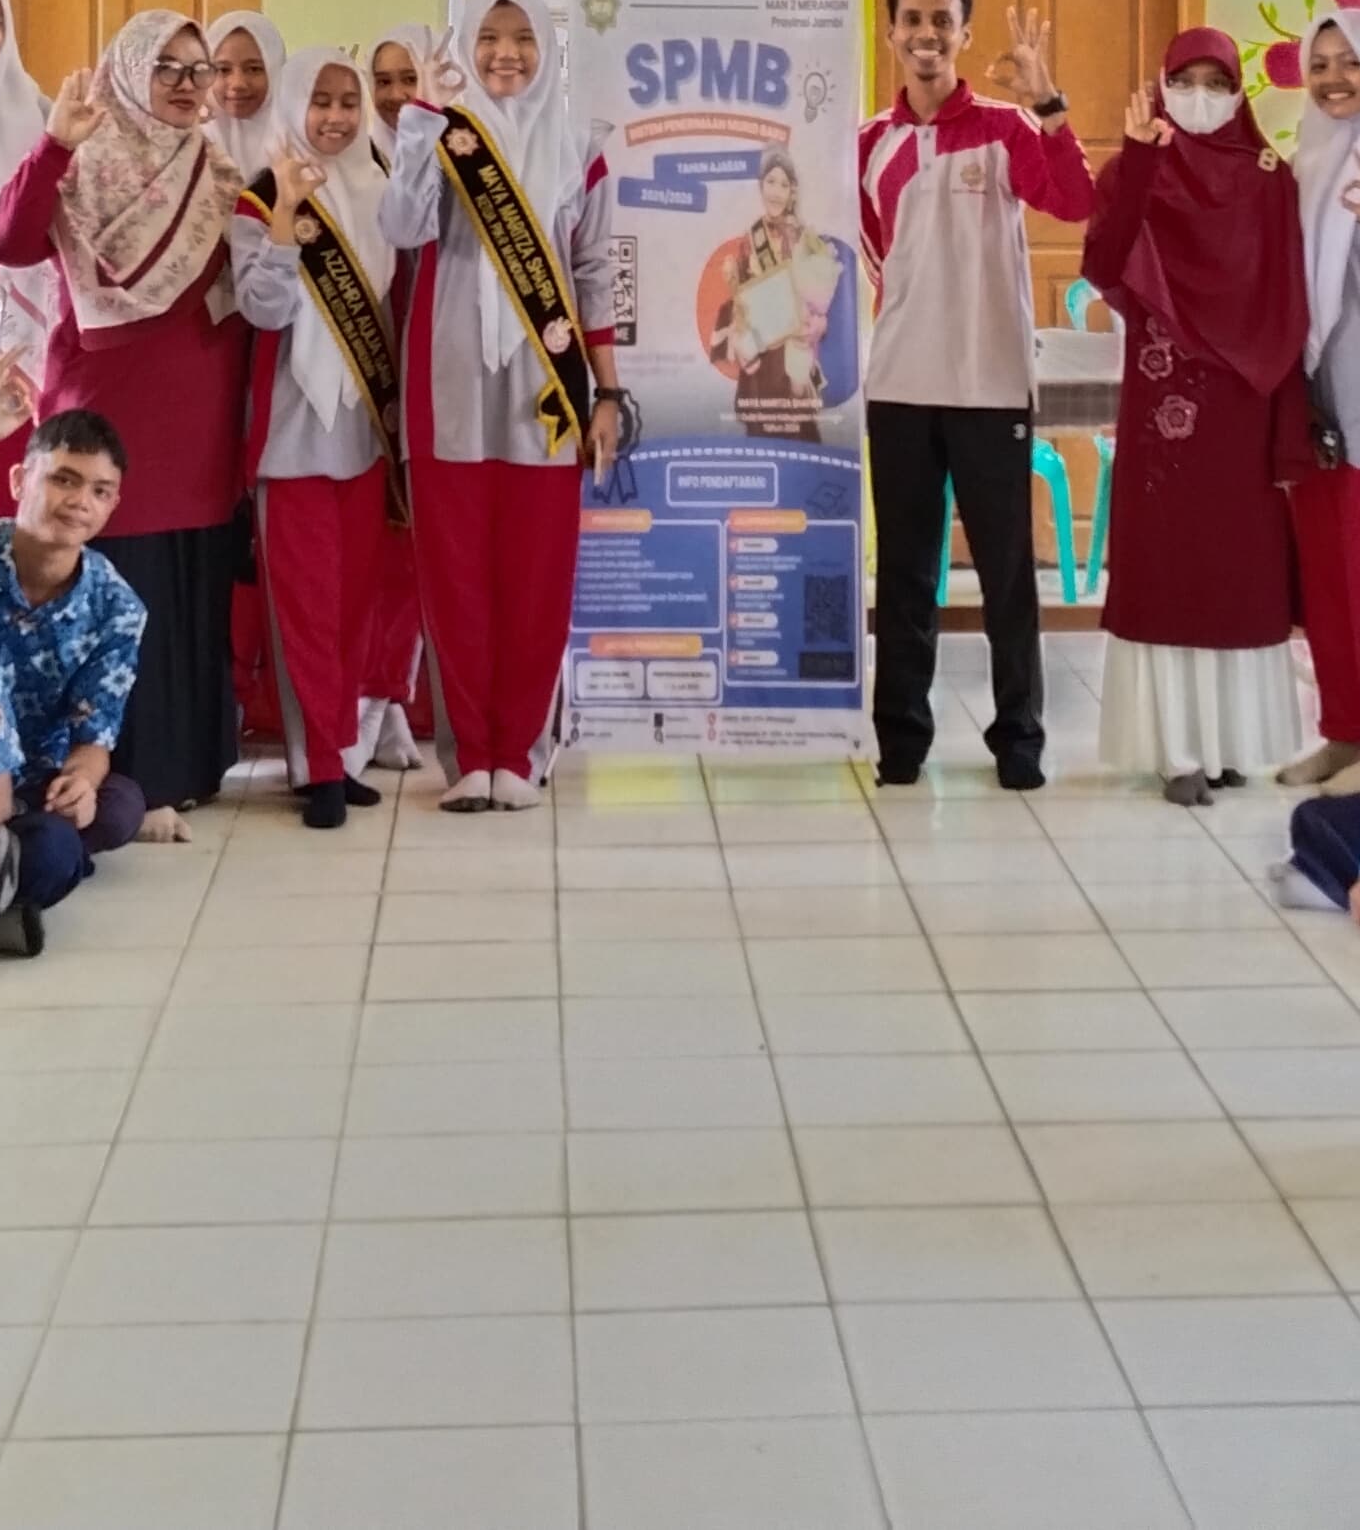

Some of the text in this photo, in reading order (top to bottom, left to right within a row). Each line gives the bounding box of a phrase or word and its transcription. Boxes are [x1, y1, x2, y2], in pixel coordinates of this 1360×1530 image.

[766, 0, 848, 10] MAN 2 MERANGIN
[625, 37, 791, 108] SPMB
[677, 160, 747, 174] TAHUN AJARAN
[477, 164, 510, 205] MAYA
[498, 201, 537, 261] MARITZA
[320, 247, 366, 315] AZZAHRA
